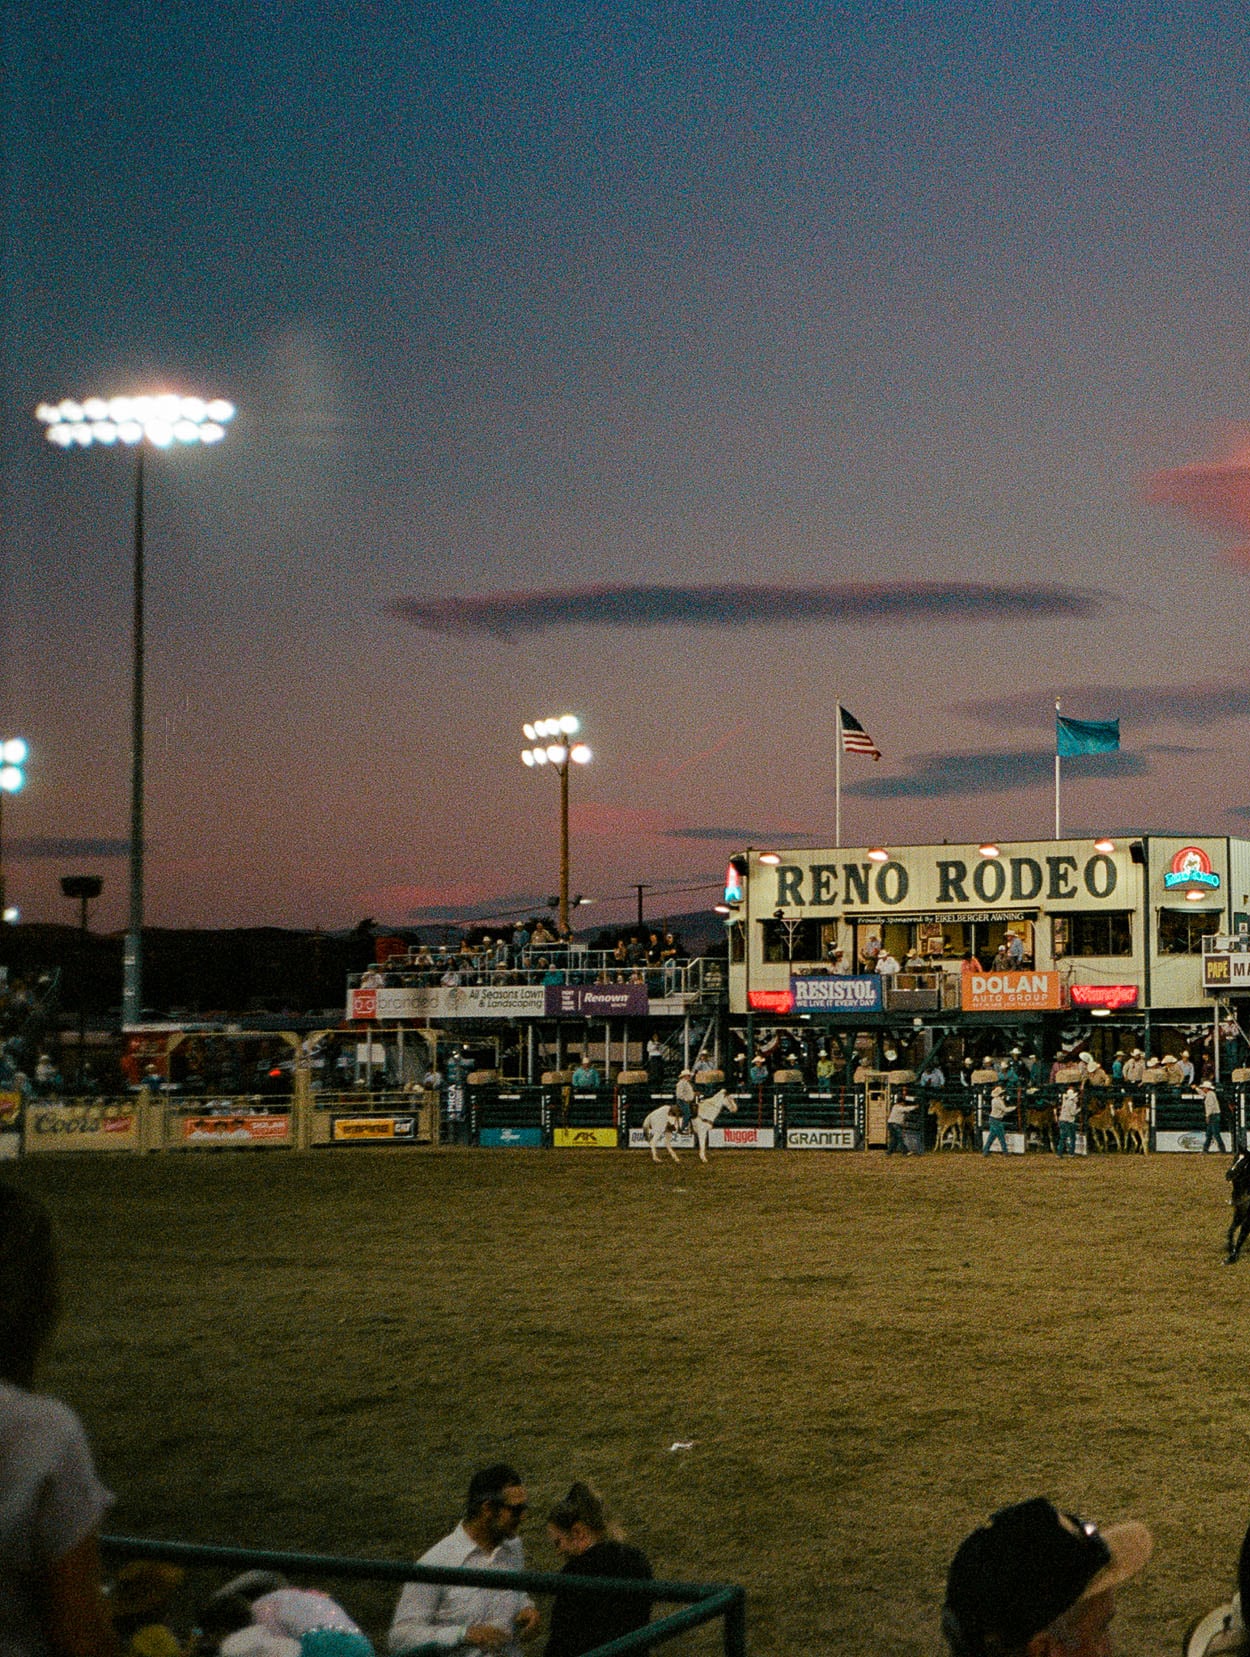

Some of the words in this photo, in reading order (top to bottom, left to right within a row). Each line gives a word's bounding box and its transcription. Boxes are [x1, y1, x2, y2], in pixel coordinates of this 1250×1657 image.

[775, 861, 909, 907] RENO
[935, 854, 1117, 903] RODEO
[858, 917, 884, 925] Proudly
[885, 916, 922, 925] Sponsored
[935, 914, 989, 922] EIKELBERGER
[990, 912, 1024, 921] AWNING
[795, 980, 876, 1000] RESISTOL
[971, 975, 1048, 994] DOLAN
[469, 989, 480, 999] All
[482, 989, 518, 999] Seasons
[520, 989, 543, 999] Lawn
[584, 992, 629, 1003] Renown
[973, 994, 1002, 1003] AUTO
[1008, 993, 1048, 1002] GROUP
[1072, 986, 1136, 1008] Wrangler
[487, 1000, 542, 1009] Landscaping
[35, 1112, 100, 1134] Coors
[723, 1128, 759, 1145] Nugget
[788, 1132, 851, 1145] GRANITE
